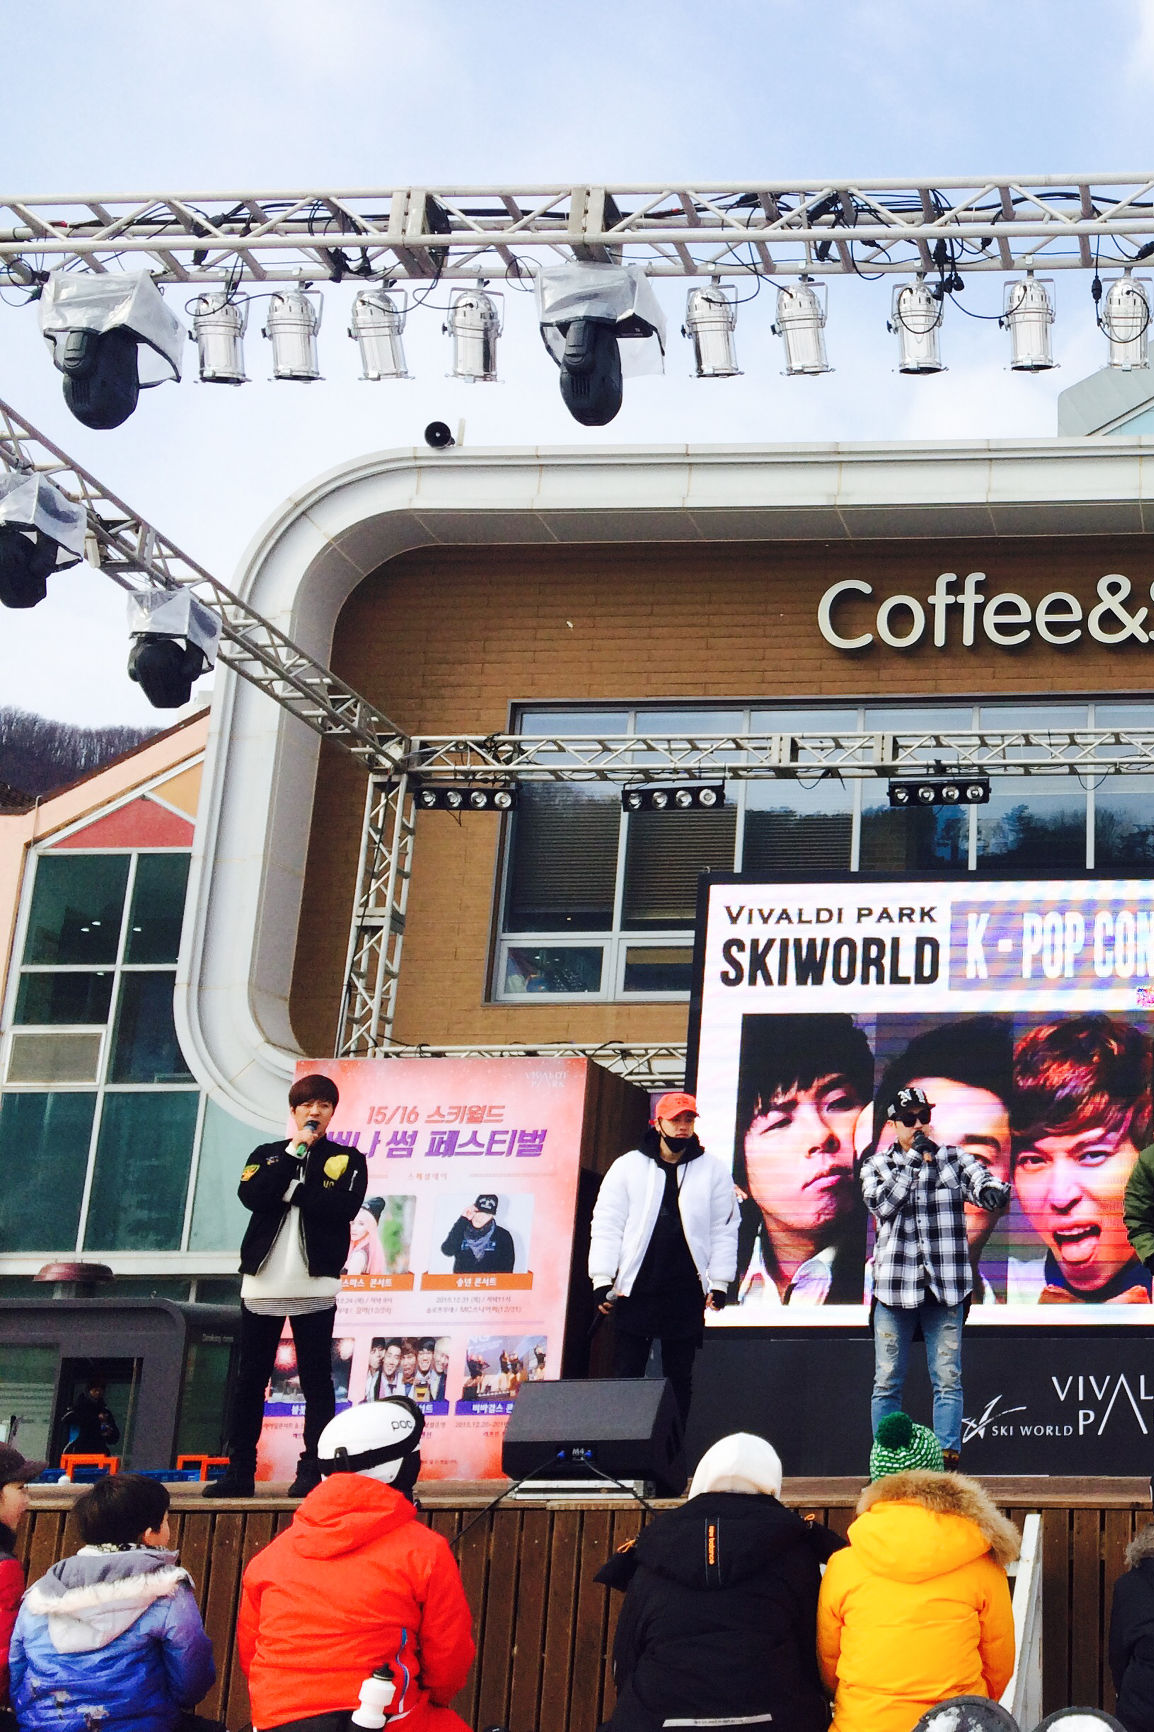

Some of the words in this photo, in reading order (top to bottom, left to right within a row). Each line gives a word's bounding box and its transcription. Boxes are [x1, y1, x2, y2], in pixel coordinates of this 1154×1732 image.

[724, 905, 844, 925] VIVALDI
[856, 906, 938, 924] PARK
[965, 912, 990, 979] K
[1021, 911, 1087, 979] POP
[720, 936, 940, 987] SKIWORLD
[366, 1105, 420, 1125] 15/16
[424, 1105, 506, 1125] 스키월드
[386, 1130, 419, 1158] 썸
[424, 1129, 548, 1158] 페스티벌
[992, 1425, 1013, 1437] SKI
[1020, 1425, 1073, 1437] WORLD
